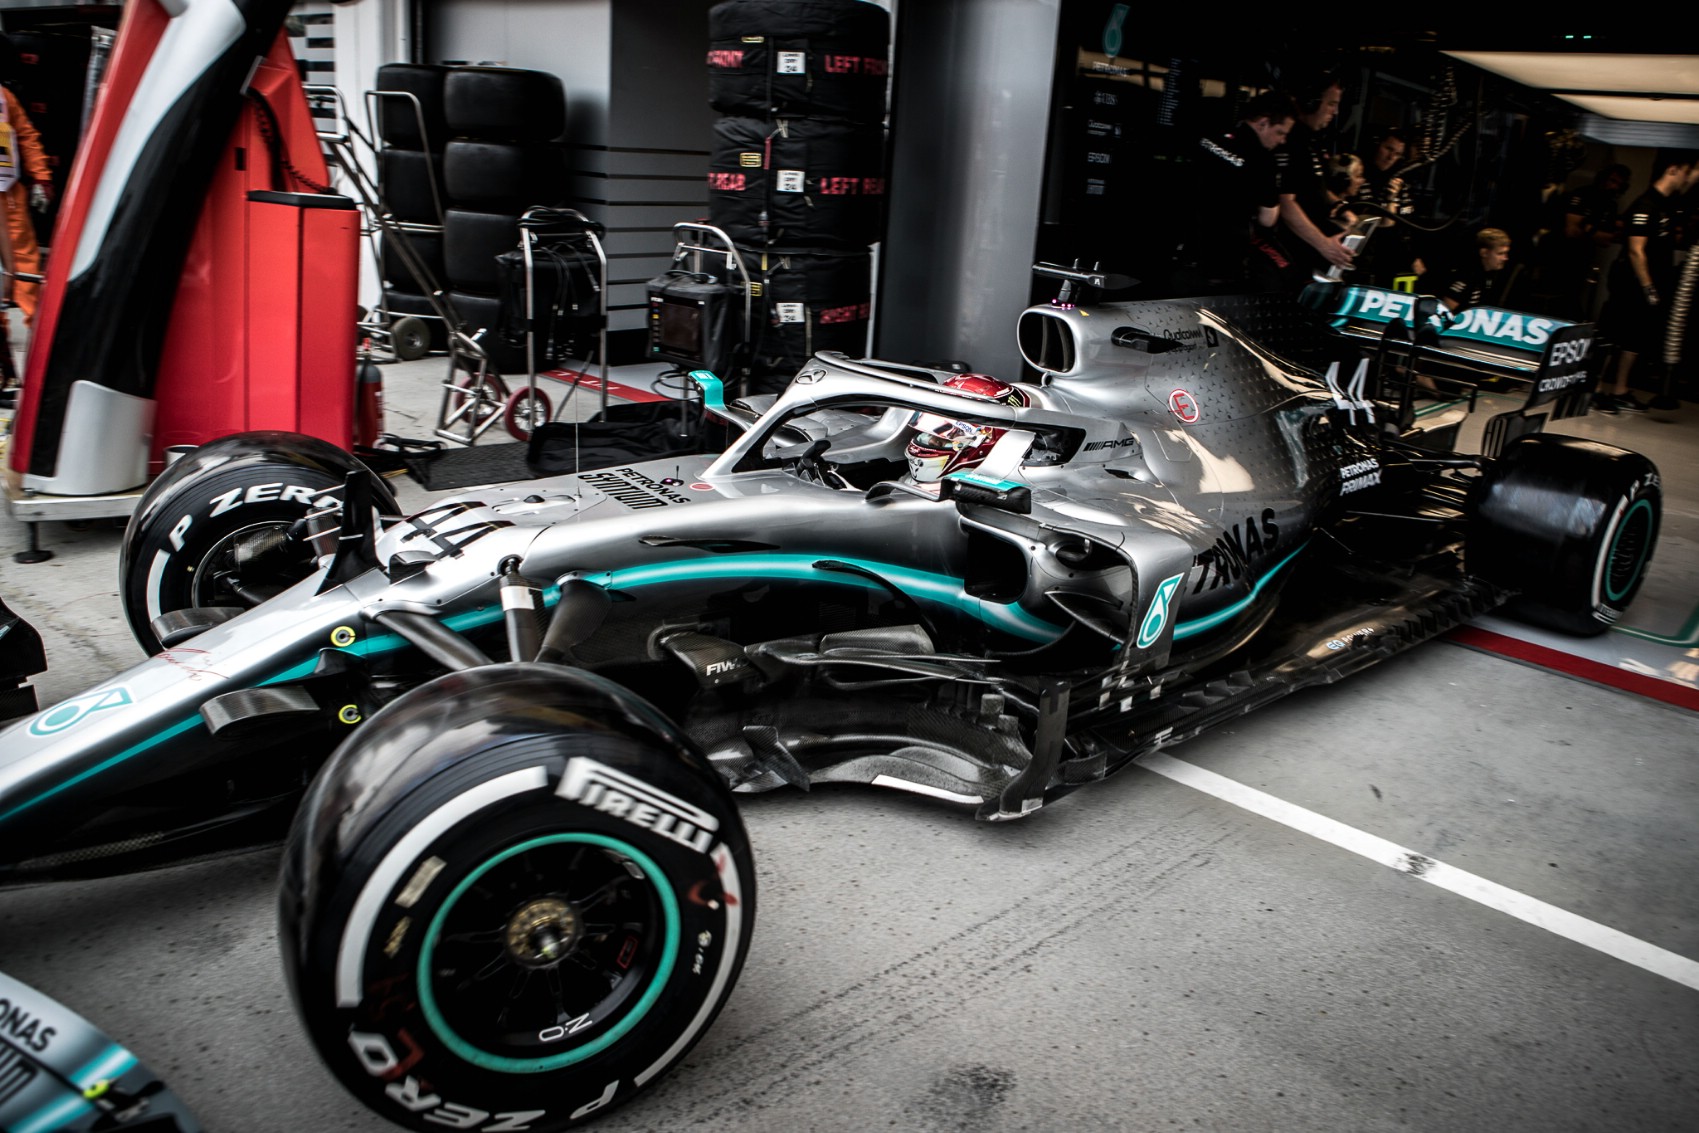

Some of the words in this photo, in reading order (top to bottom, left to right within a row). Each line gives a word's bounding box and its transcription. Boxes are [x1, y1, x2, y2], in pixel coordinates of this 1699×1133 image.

[824, 54, 860, 74] LEFT
[819, 177, 860, 196] LEFT
[1324, 357, 1376, 426] 44
[1103, 437, 1135, 450] AMG
[615, 467, 692, 505] PETRONAS
[1340, 458, 1380, 479] PETRONAS
[169, 514, 193, 552] P
[400, 500, 517, 560] 44
[1189, 508, 1279, 596] TRONAS
[555, 756, 720, 854] PIRELLI
[347, 1031, 546, 1132] ZERO
